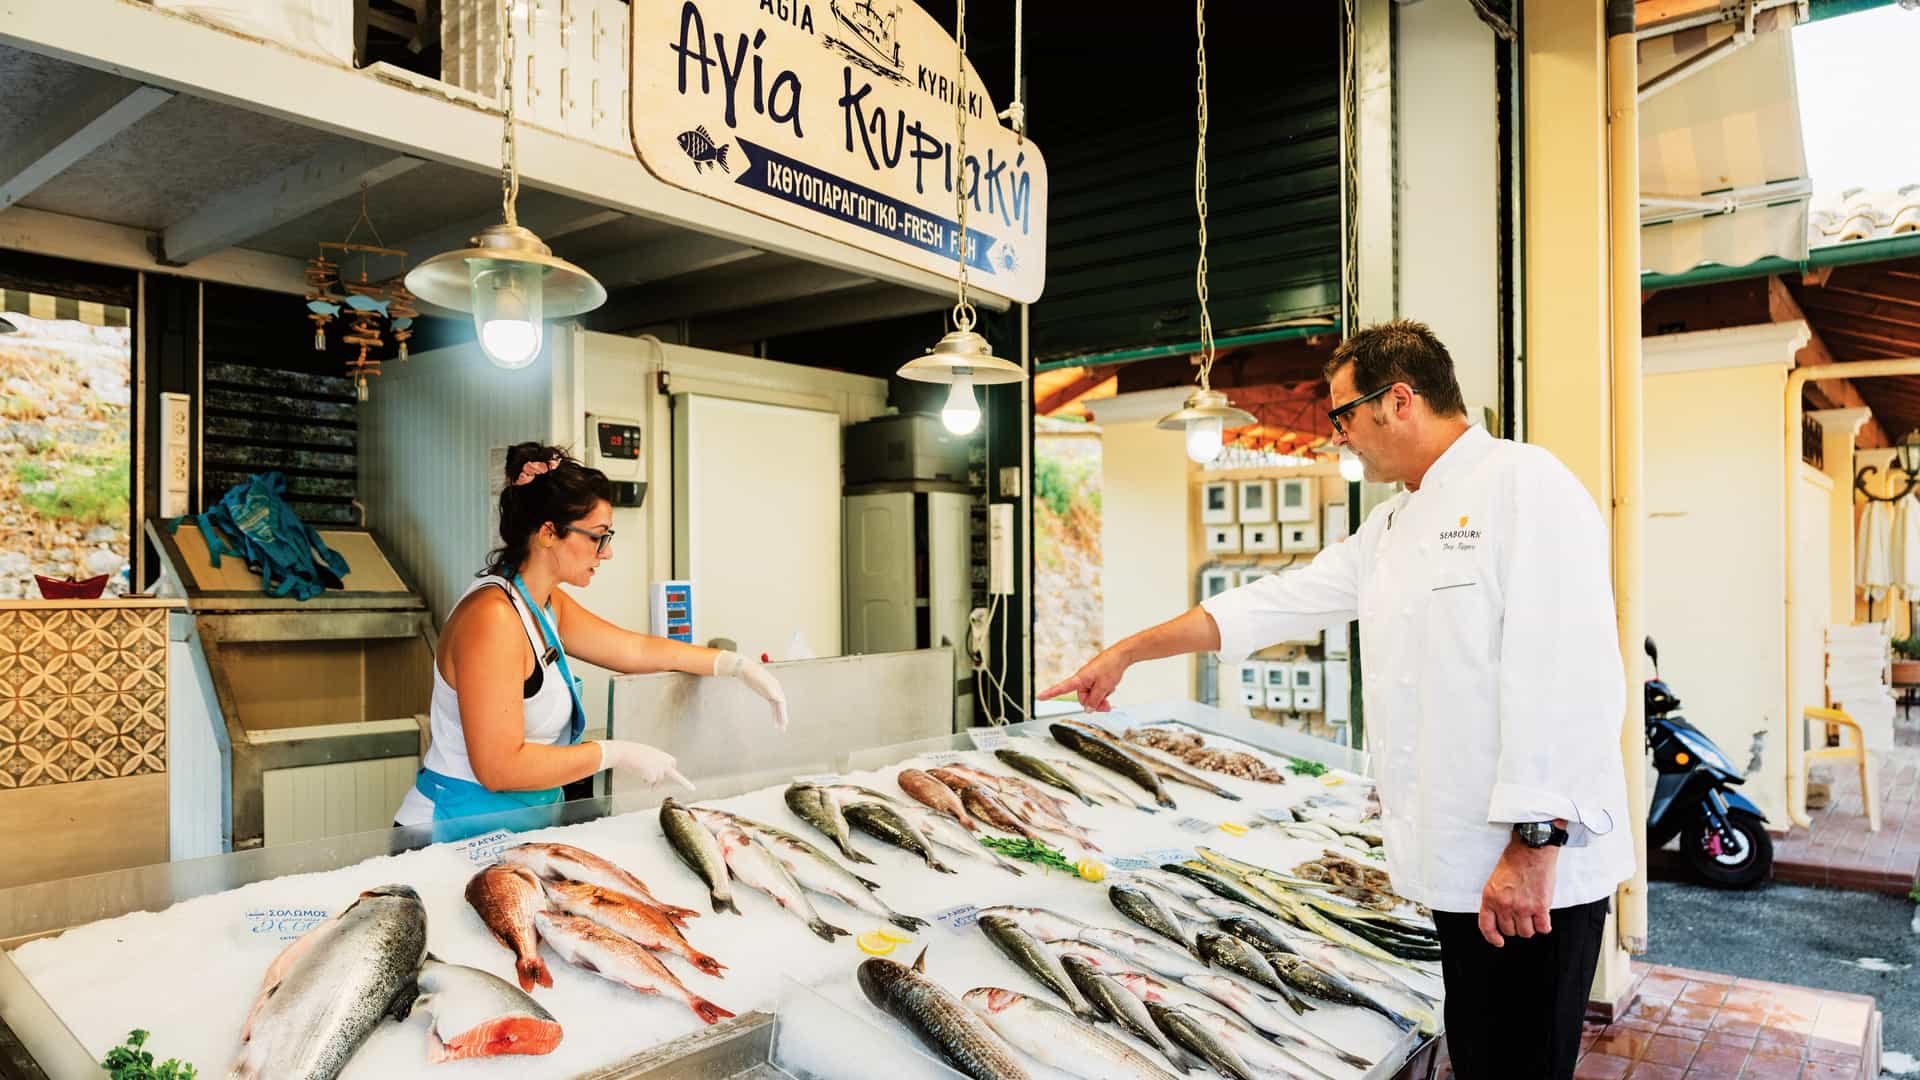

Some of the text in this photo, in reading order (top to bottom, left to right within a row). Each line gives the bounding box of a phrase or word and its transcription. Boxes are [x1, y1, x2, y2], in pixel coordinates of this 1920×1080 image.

[670, 1, 804, 138] Αγία
[950, 229, 976, 261] FH
[269, 909, 328, 917] ΣΟΛΩΜΟΣ
